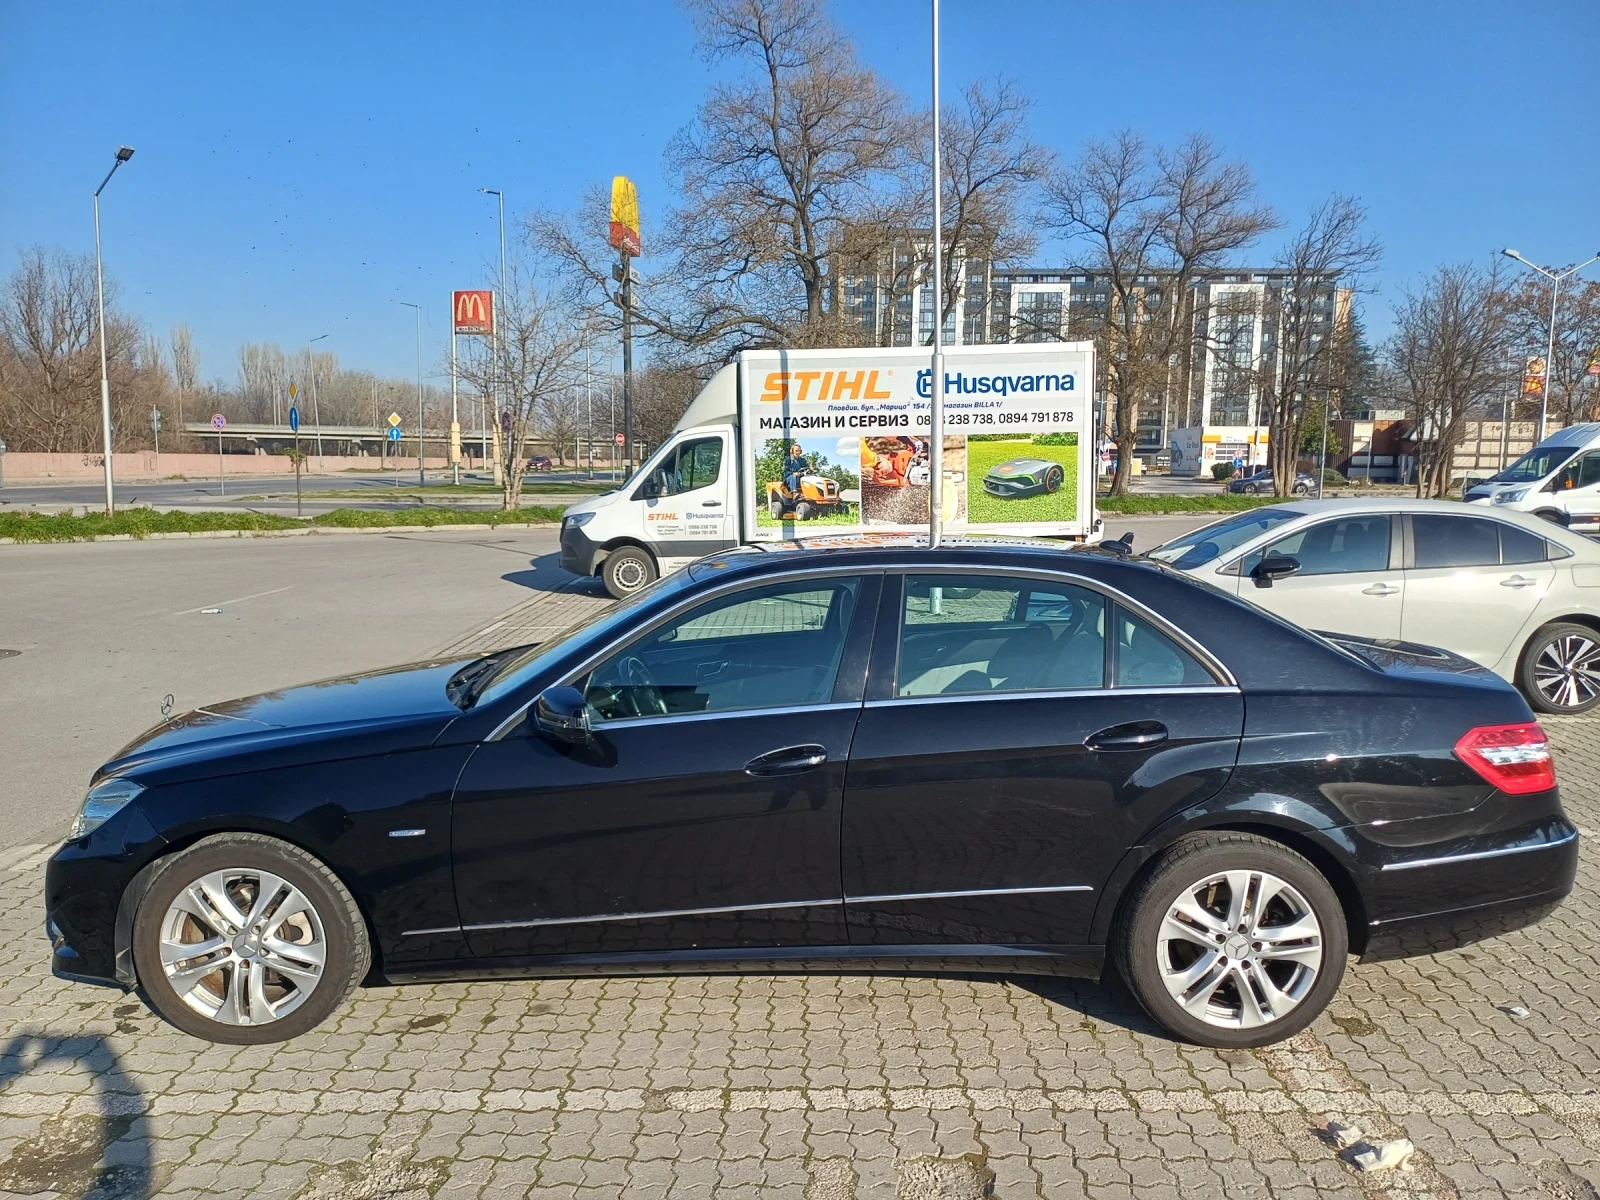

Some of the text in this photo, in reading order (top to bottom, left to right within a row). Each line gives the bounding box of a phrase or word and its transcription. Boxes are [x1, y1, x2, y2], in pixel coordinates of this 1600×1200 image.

[760, 370, 891, 401] STIHL
[944, 372, 1075, 397] Husqvarna
[827, 404, 860, 412] Пловдив,
[860, 404, 876, 413] бул.
[912, 402, 926, 410] 154
[973, 401, 995, 409] BILLA
[759, 414, 909, 430] МАГАЗИН И СЕРВИЗ
[916, 411, 1074, 426] 08 238 738, 0894 791 878
[647, 512, 679, 521] STIHL
